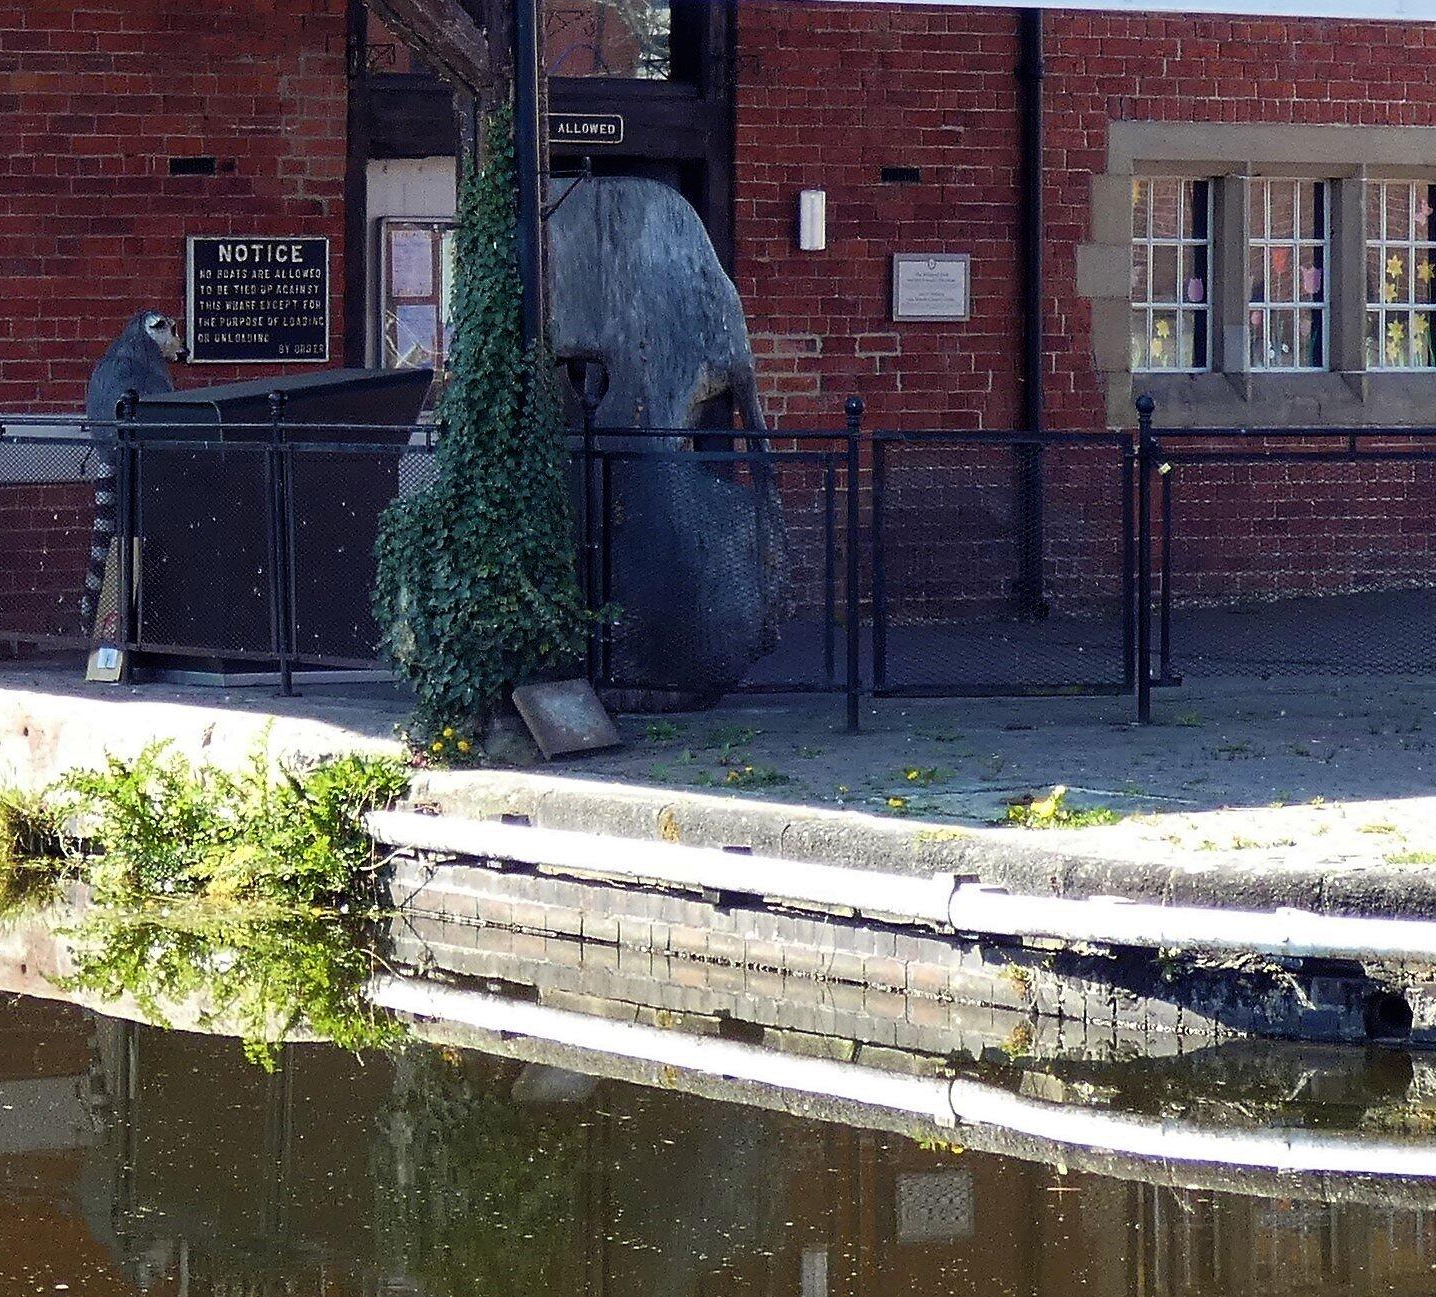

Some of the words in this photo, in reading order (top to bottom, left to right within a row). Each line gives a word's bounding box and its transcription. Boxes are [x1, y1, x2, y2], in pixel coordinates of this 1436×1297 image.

[557, 123, 616, 135] ALLOWED
[218, 244, 303, 263] NOTICE
[199, 269, 212, 279] NO
[216, 269, 247, 279] BOATS
[251, 269, 271, 279] ARE
[274, 268, 321, 279] ALLOWED
[200, 285, 212, 295] TO
[217, 285, 228, 295] BE
[233, 285, 257, 295] TIED
[260, 285, 273, 295] UP
[275, 285, 319, 295] AGAINST
[199, 300, 221, 311] THIS
[225, 300, 257, 311] WHARF
[259, 299, 298, 310] EXCEPT
[302, 299, 322, 310] FOR
[198, 317, 216, 327] THE
[220, 316, 264, 327] PURPOSE
[267, 316, 280, 326] OF
[283, 316, 325, 327] LOADING
[197, 333, 210, 343] OR
[278, 344, 291, 354] BY
[294, 344, 325, 354] ORDER
